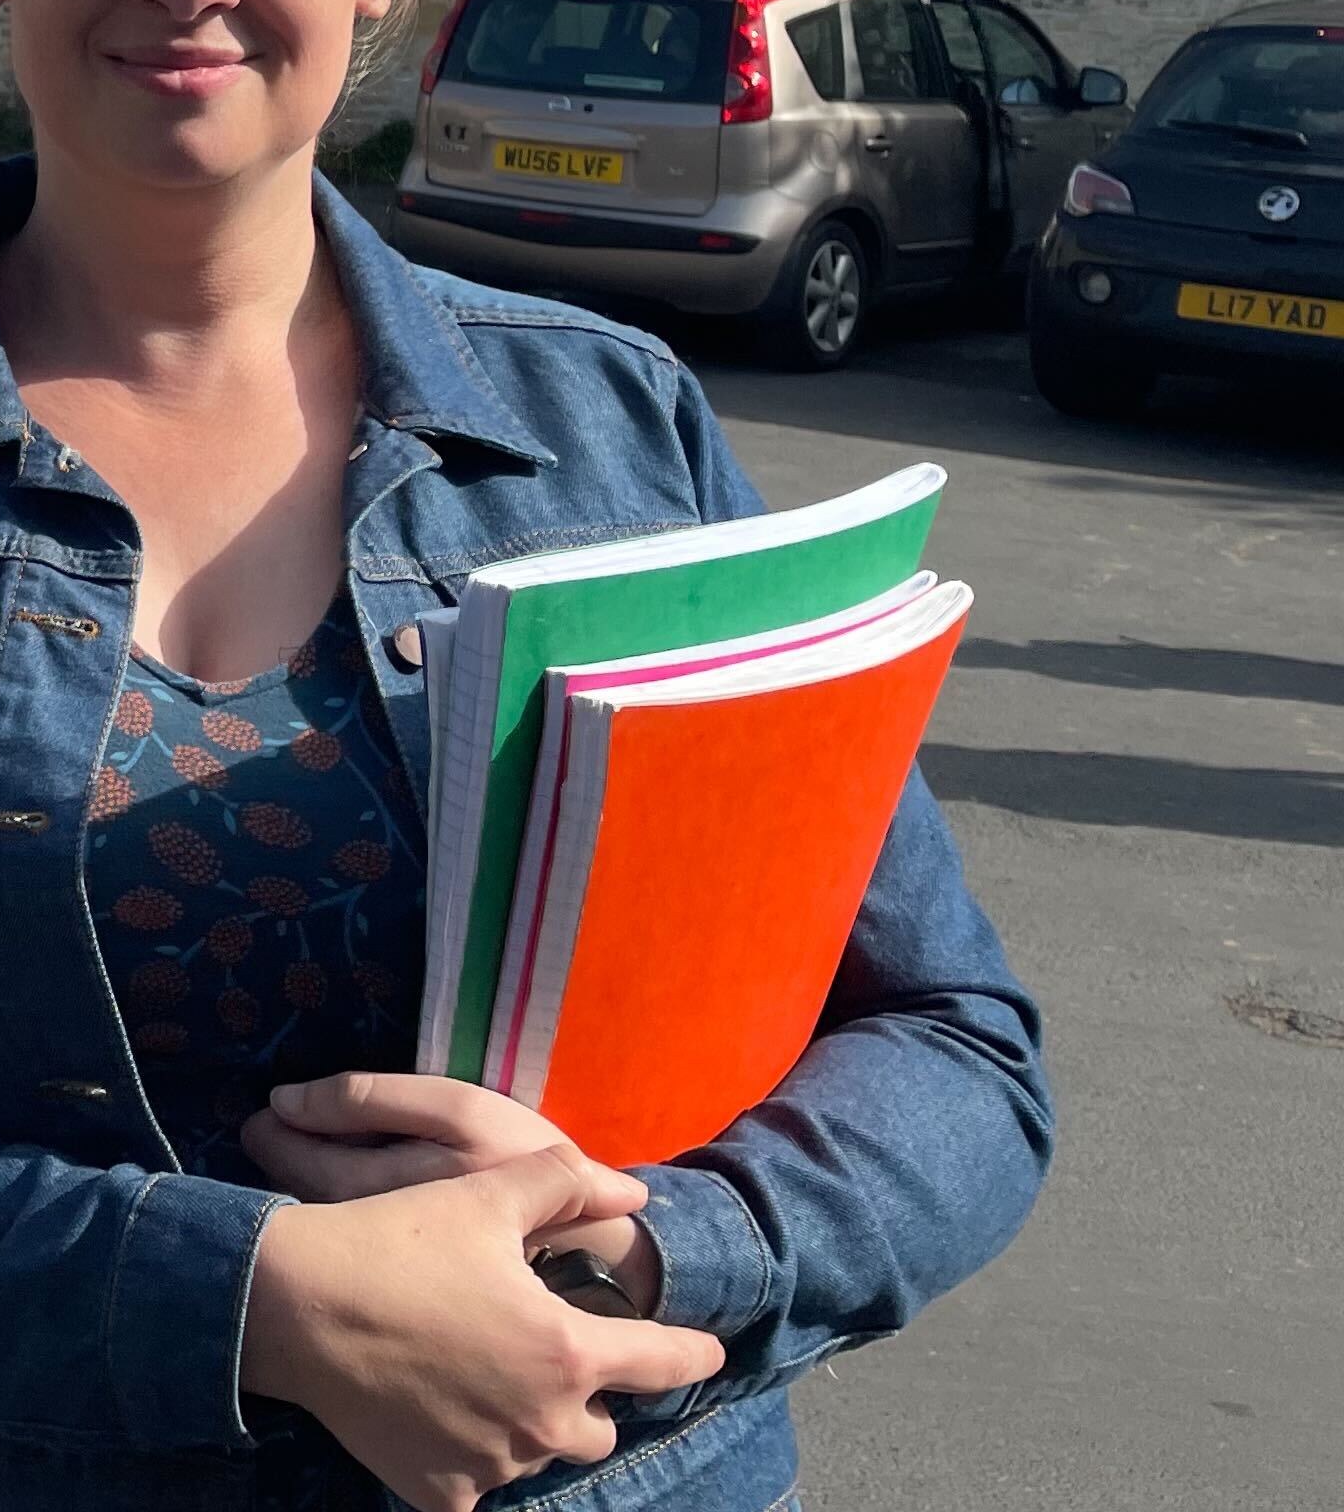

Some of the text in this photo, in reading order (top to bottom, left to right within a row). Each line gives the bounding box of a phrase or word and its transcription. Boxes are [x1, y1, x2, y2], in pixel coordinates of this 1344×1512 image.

[504, 145, 613, 178] WU56 LVF
[1207, 290, 1327, 329] L17 YAD
